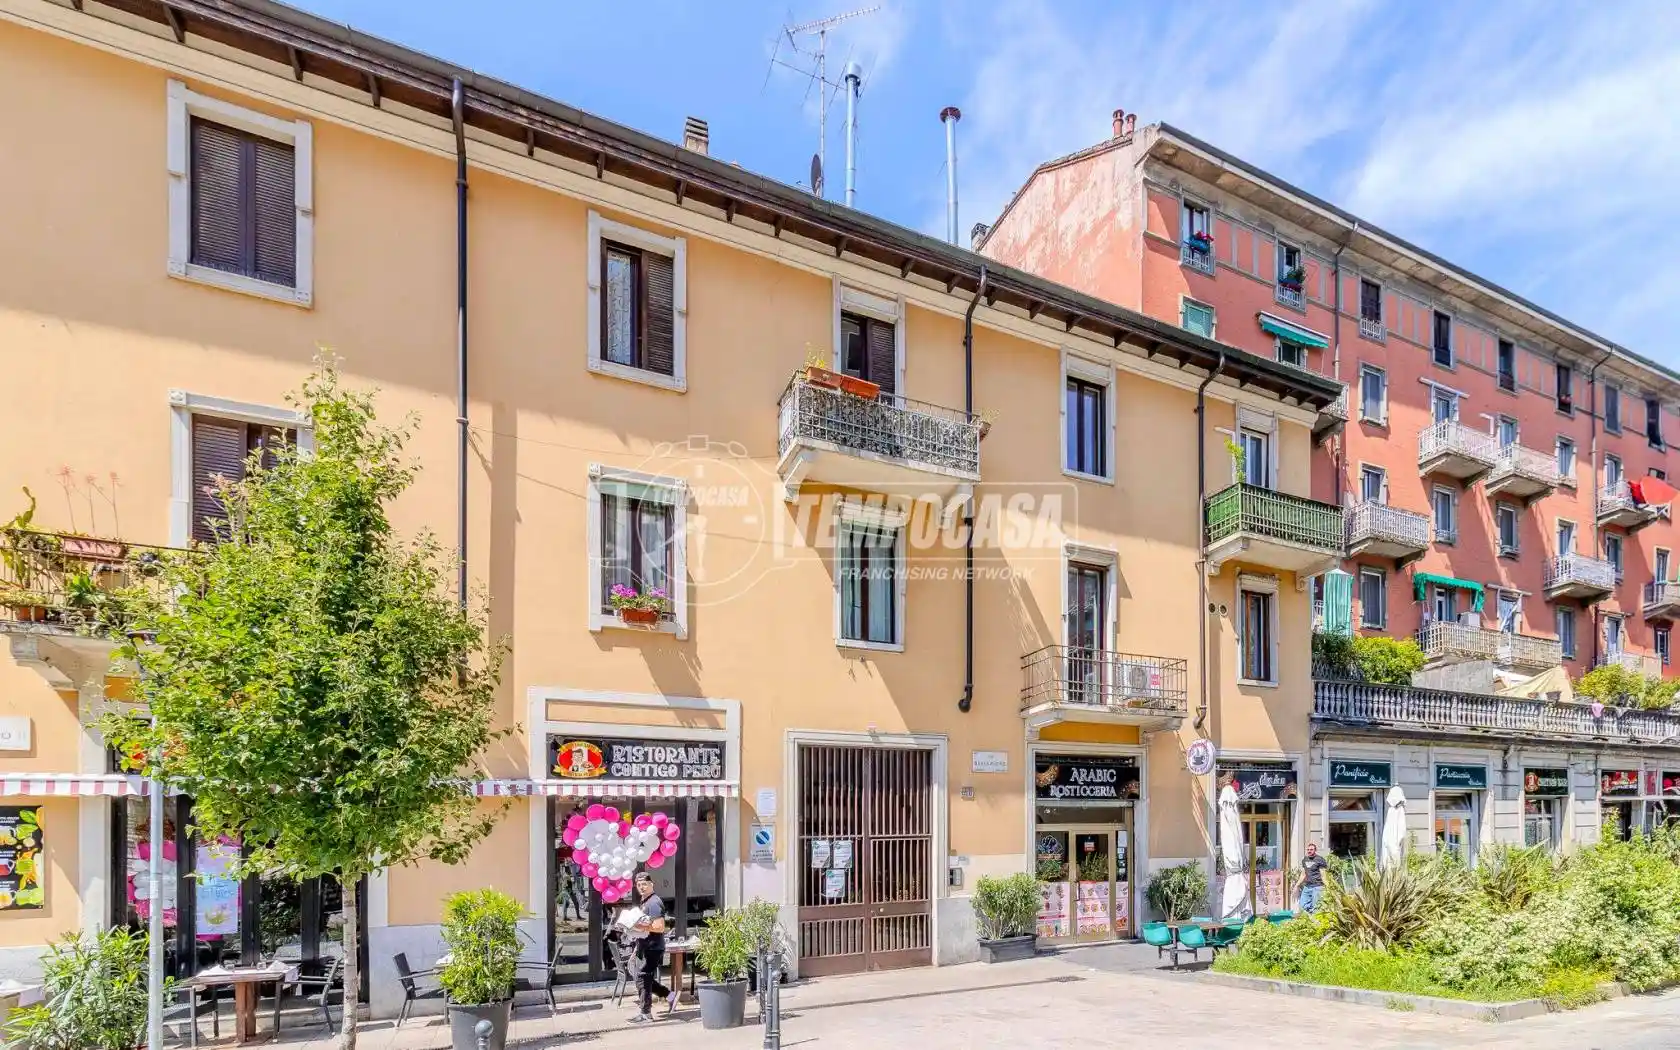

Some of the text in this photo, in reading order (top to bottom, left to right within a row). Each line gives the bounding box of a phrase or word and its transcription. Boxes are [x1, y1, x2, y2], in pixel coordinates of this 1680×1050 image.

[612, 744, 720, 765] RISTORANTE
[611, 763, 679, 777] CONTIGO
[1070, 767, 1117, 785] ARABIC
[1049, 785, 1117, 798] ROSTICCERIA
